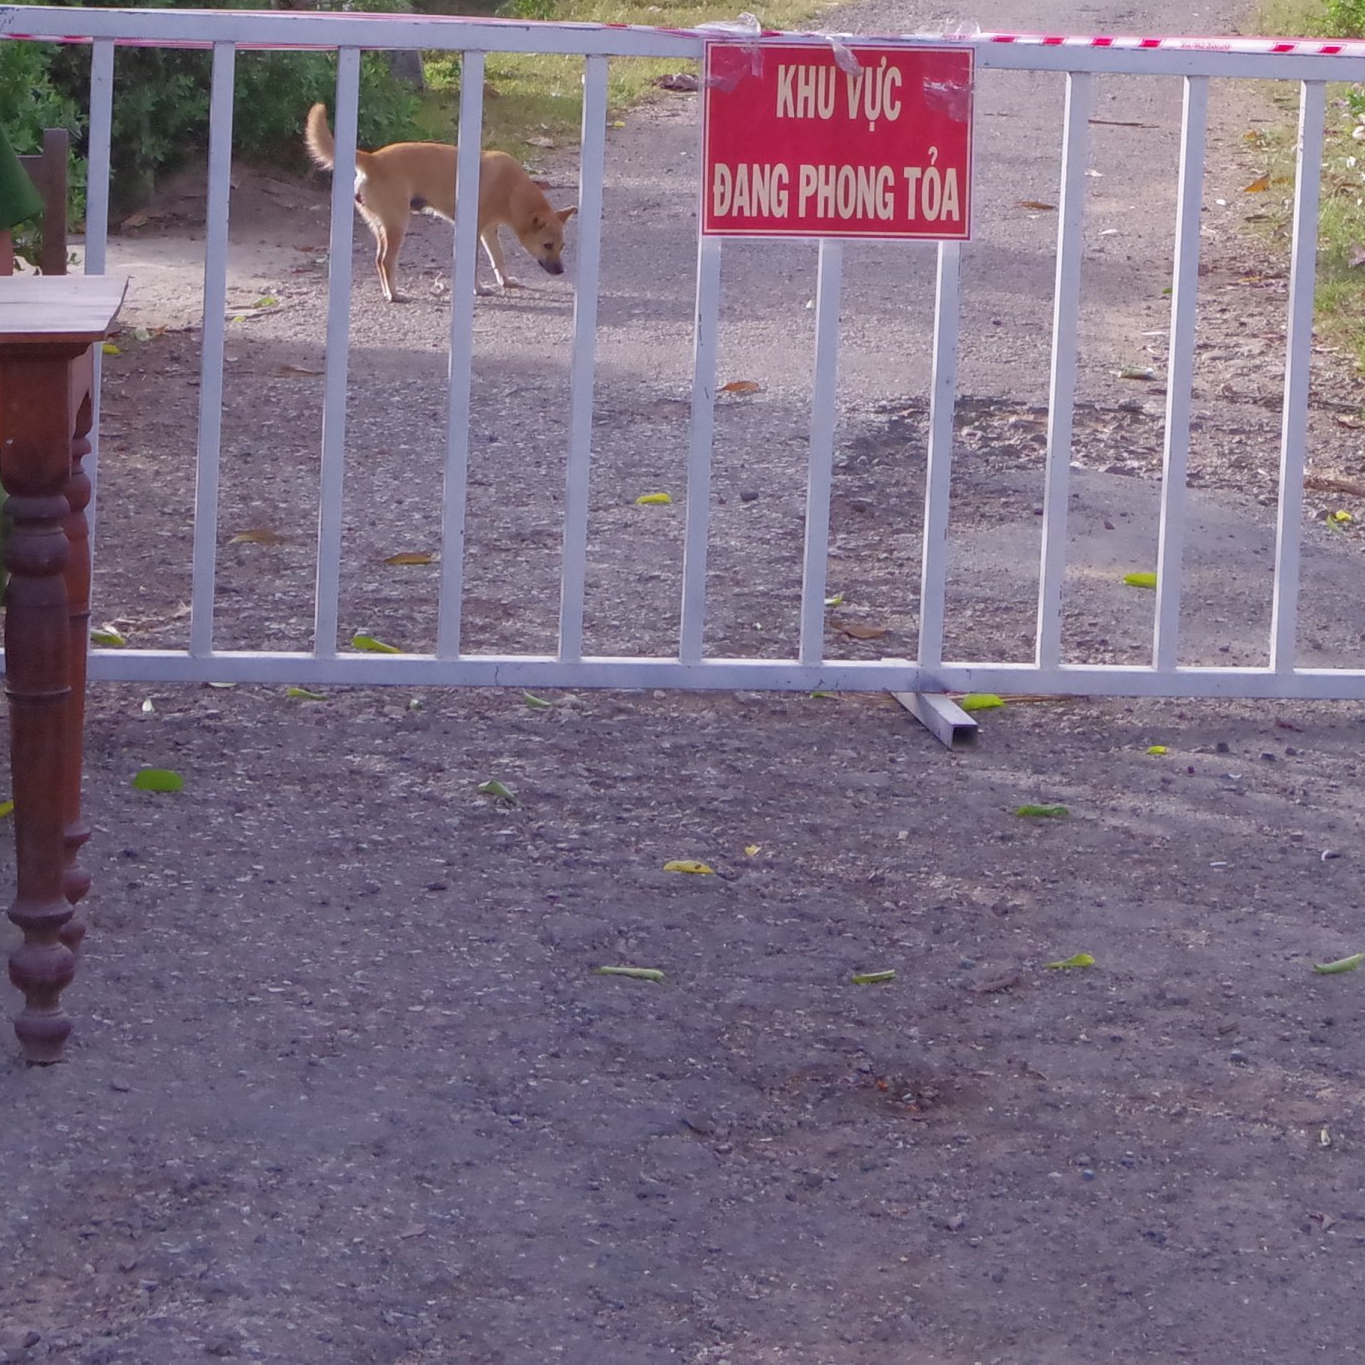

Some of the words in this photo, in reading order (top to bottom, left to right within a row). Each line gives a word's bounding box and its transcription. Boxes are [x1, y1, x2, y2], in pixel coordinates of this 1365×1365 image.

[776, 64, 836, 120] KHU
[846, 55, 903, 132] VỰC
[713, 162, 790, 219] ĐANG
[798, 164, 896, 221] PHONG
[903, 145, 960, 222] TỎA
